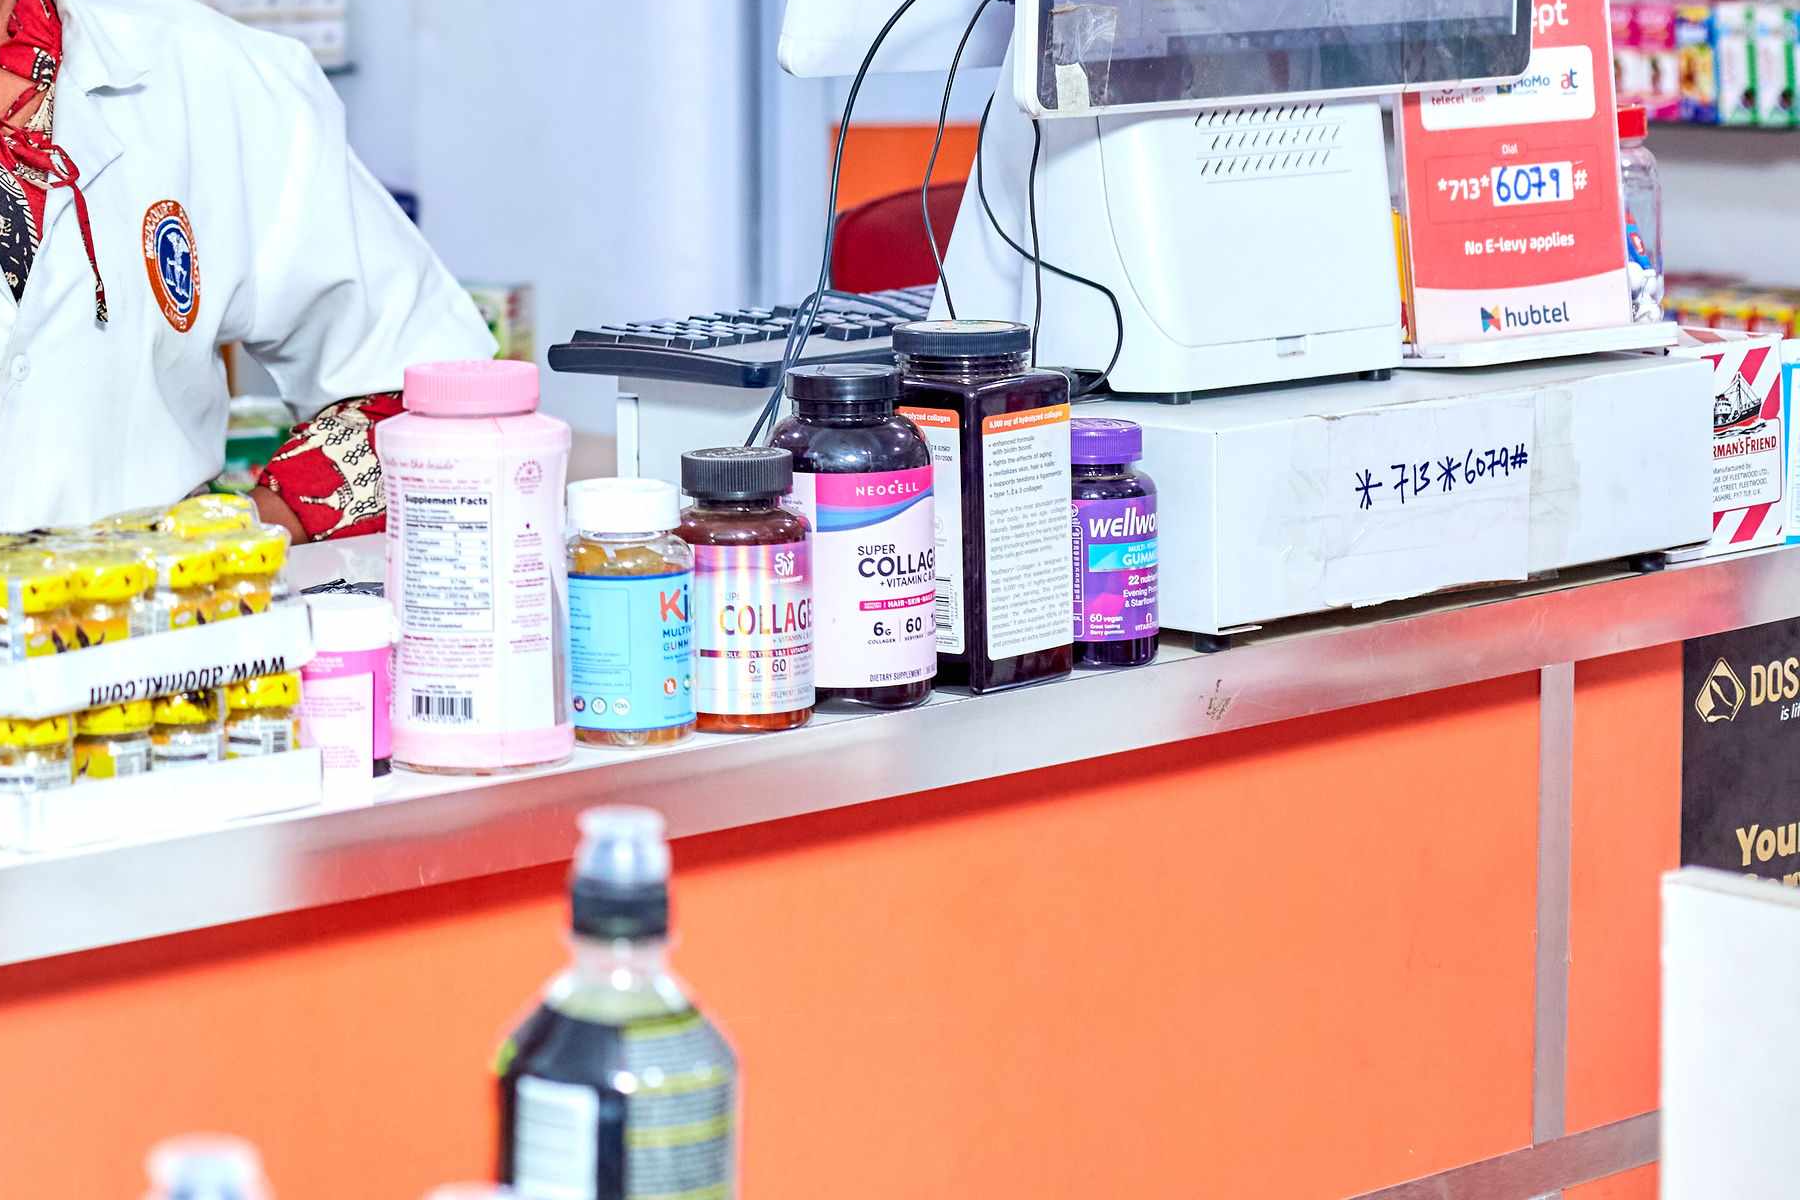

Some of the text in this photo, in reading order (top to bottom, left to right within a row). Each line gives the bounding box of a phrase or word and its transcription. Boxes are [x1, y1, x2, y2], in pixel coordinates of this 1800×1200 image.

[1502, 144, 1518, 155] Dial
[1465, 232, 1575, 255] No E-levy applies
[1505, 302, 1570, 327] hubtel
[1745, 436, 1777, 455] FRIEND
[855, 480, 919, 497] NEOCELL
[405, 494, 487, 506] Supplement Facts
[1088, 507, 1158, 538] wellwo
[857, 544, 896, 556] SUPER
[858, 546, 935, 578] COLLAG
[886, 575, 922, 588] VITAMIN
[1128, 575, 1139, 585] 22
[1123, 587, 1147, 598] Evening
[659, 584, 690, 622] Ki
[906, 616, 922, 633] 60
[1090, 613, 1123, 625] 60 vegan
[772, 659, 787, 673] 60
[1780, 706, 1790, 721] is
[1736, 822, 1800, 866] You
